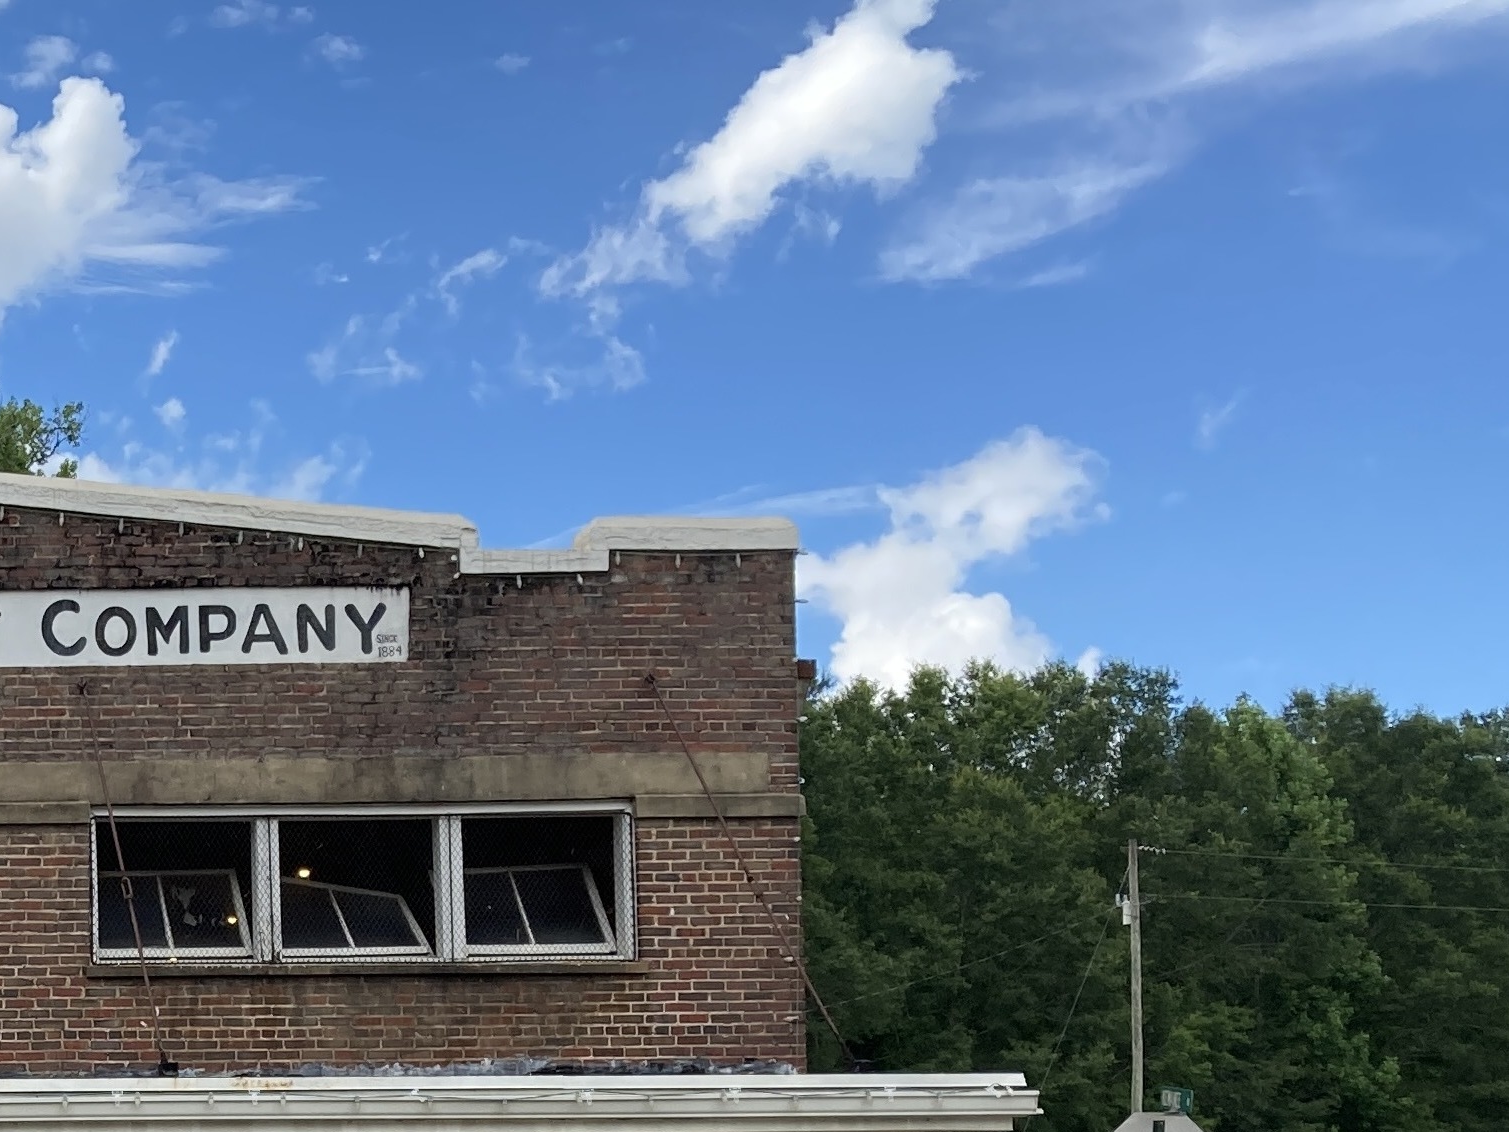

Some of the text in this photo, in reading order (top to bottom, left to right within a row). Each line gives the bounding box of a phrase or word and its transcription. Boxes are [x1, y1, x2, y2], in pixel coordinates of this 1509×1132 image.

[42, 599, 387, 657] COMPANY
[376, 634, 398, 643] SINCE
[378, 645, 402, 657] 1884
